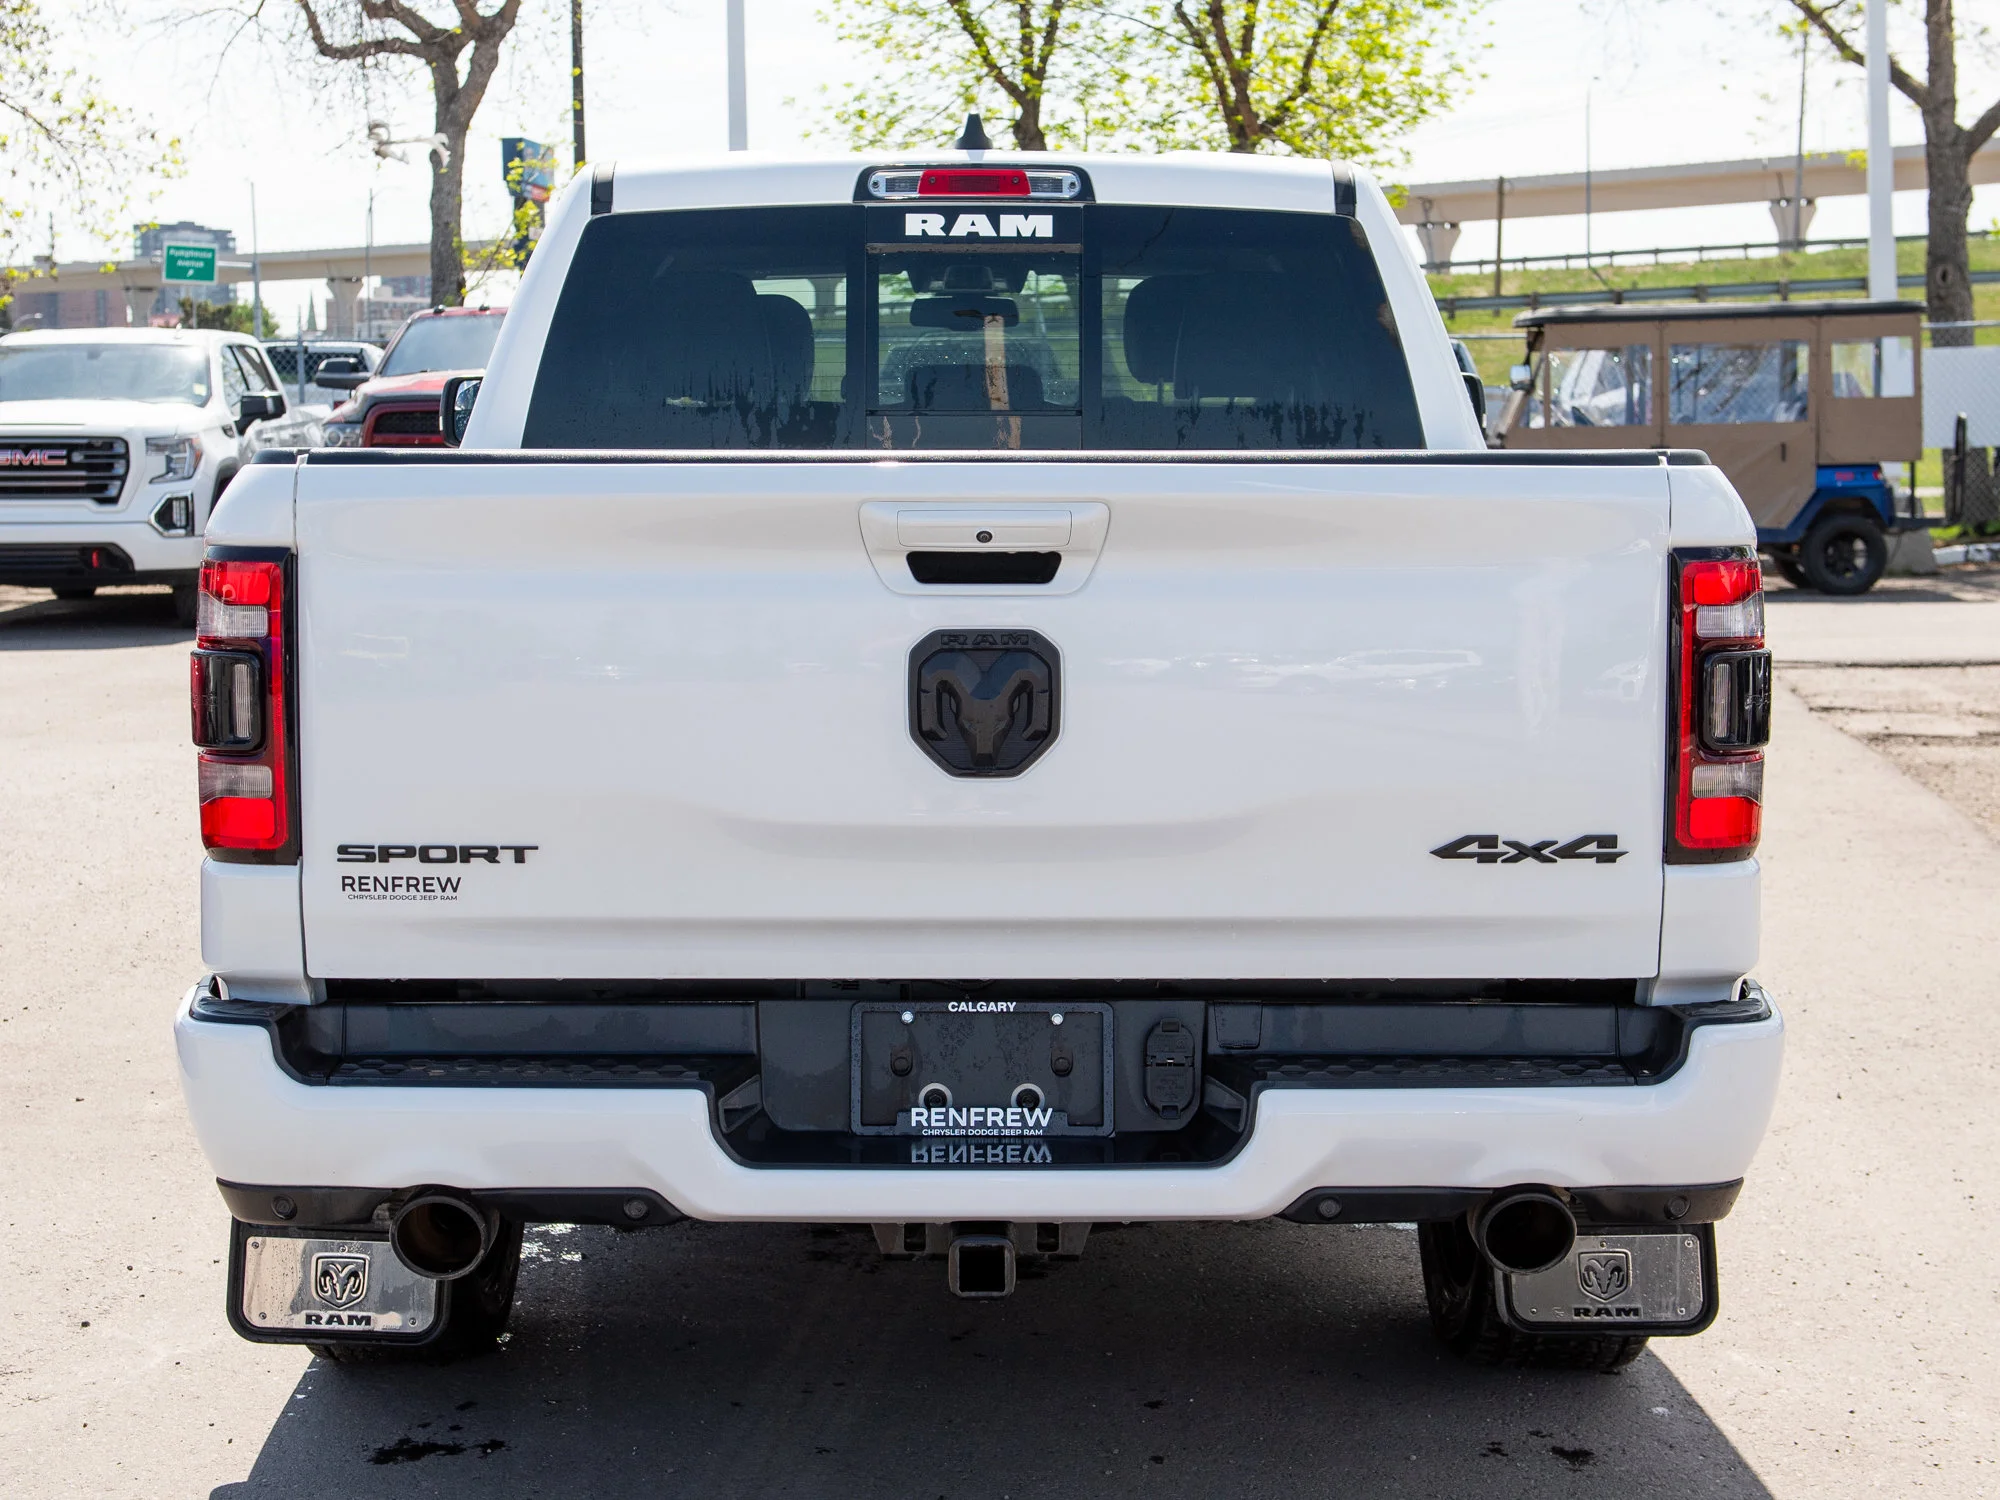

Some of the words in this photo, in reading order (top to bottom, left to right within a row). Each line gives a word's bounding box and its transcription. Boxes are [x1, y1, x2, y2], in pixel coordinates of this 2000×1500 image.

[905, 213, 1053, 237] RAM
[176, 259, 204, 268] Avenue
[941, 634, 1029, 645] RAM
[337, 844, 539, 863] SPORT
[1429, 834, 1629, 863] 4x4
[341, 875, 461, 893] RENFREW
[948, 1001, 1017, 1012] CALGARY
[911, 1107, 1053, 1127] RENFREW
[922, 1128, 966, 1136] CHRYSLER
[968, 1128, 999, 1136] DODGE
[1000, 1128, 1021, 1136] JEEP
[1023, 1128, 1043, 1136] RAM
[1573, 1307, 1640, 1318] RAM
[305, 1314, 372, 1326] RAM
